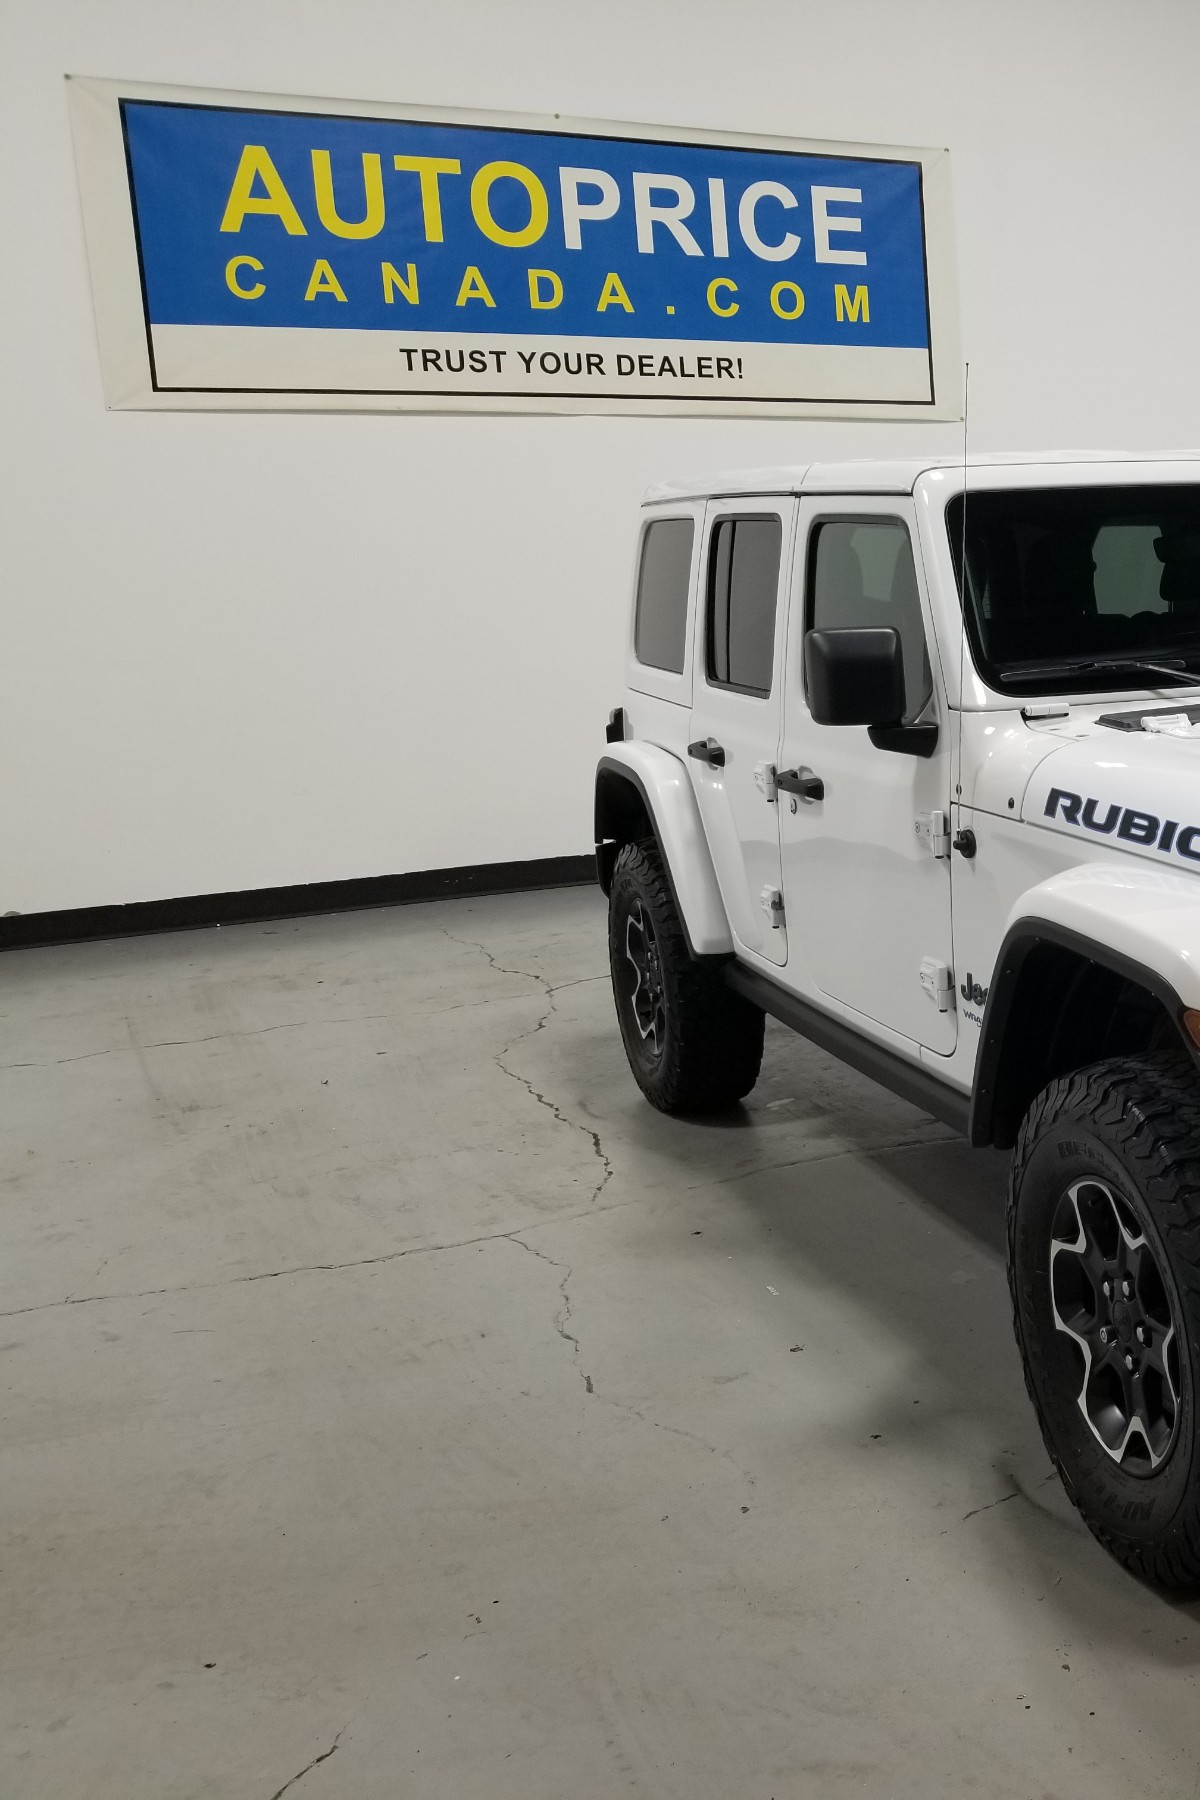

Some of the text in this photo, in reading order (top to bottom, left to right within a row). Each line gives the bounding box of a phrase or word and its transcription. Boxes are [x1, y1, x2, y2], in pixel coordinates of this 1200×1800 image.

[219, 144, 868, 266] AUTOPRICE
[225, 255, 871, 324] CANADA.COM
[399, 349, 743, 379] TRUST YOUR DEALER!
